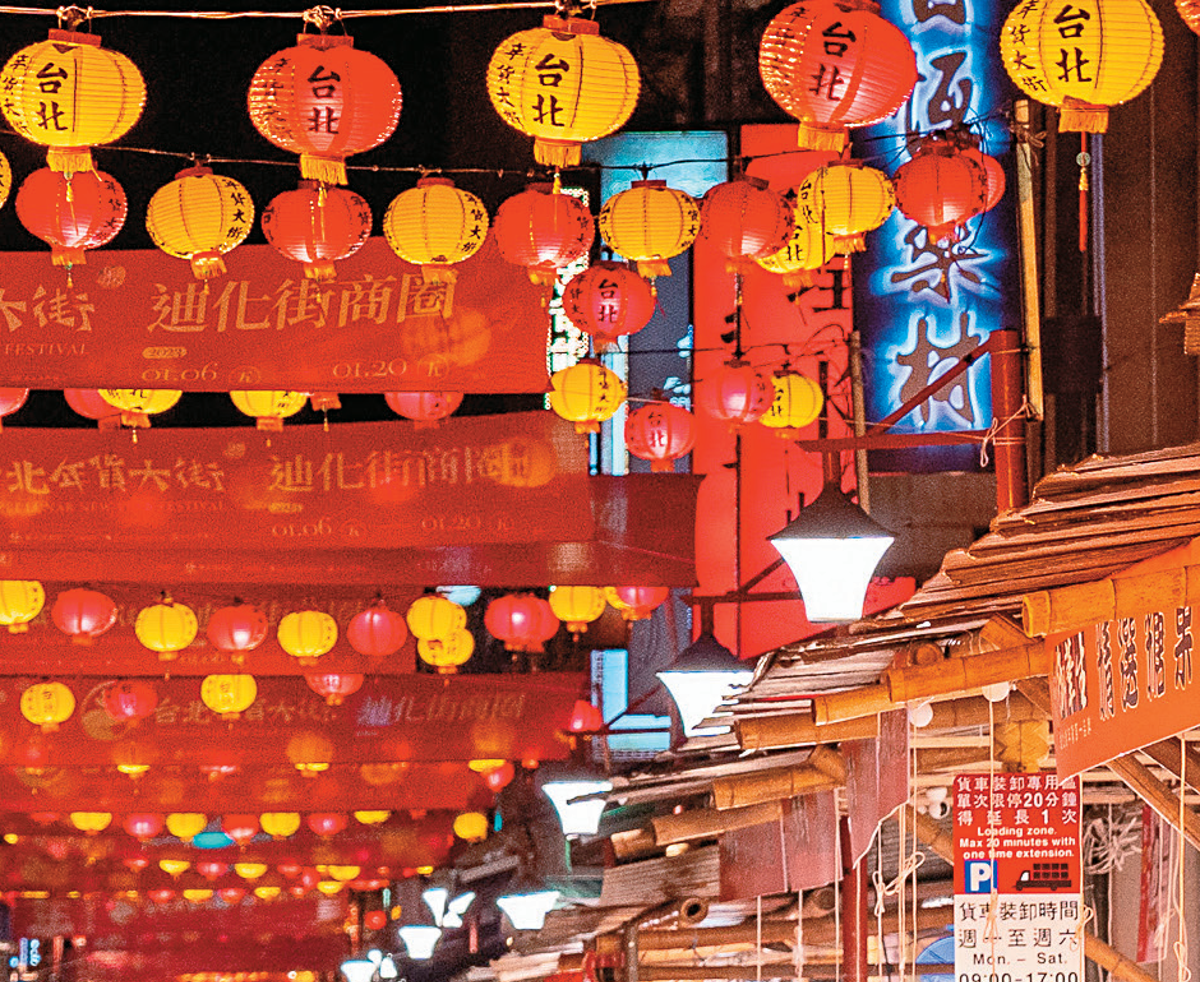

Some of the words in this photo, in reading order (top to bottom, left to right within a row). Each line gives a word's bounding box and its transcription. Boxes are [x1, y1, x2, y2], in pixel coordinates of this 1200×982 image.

[1053, 4, 1093, 83] 台北
[809, 21, 857, 101] 台北
[36, 62, 69, 132] 台北
[307, 65, 341, 135] 台北
[532, 53, 570, 127] 台北
[145, 273, 459, 334] 迪化街商圈
[599, 278, 620, 325] 台北
[3, 342, 88, 356] FESTIVAL
[141, 360, 218, 382] 01.06
[332, 357, 408, 379] 01.20
[960, 838, 983, 848] Max
[986, 838, 1000, 848] 20
[1003, 837, 1048, 847] minutes
[1051, 836, 1076, 846] with
[977, 827, 1023, 837] Loading
[1027, 828, 1057, 836] zone.
[963, 850, 985, 859] one
[1016, 848, 1075, 858] extension.
[969, 861, 992, 892] P
[973, 953, 1011, 965] Mon.
[1037, 952, 1068, 964] Sat.
